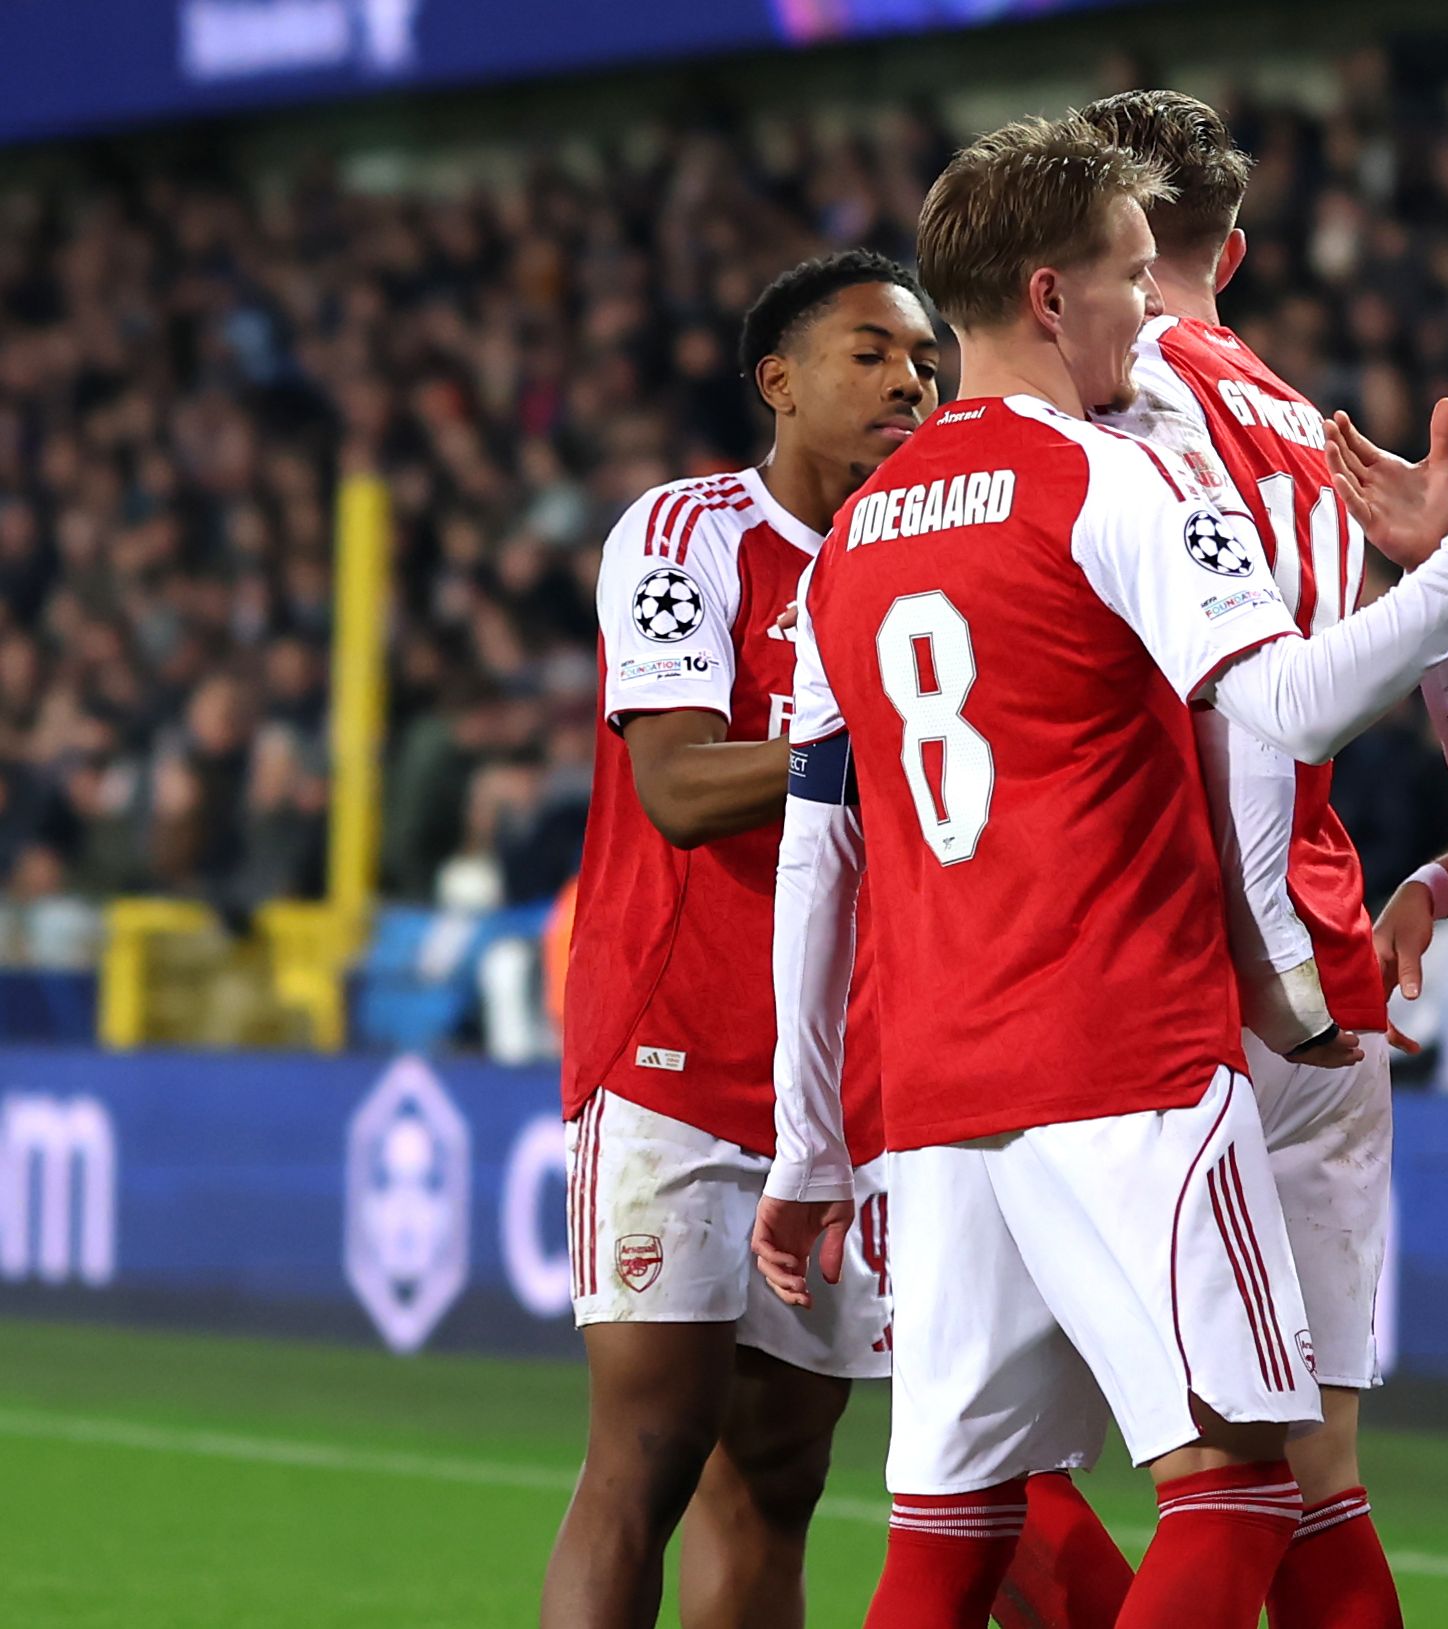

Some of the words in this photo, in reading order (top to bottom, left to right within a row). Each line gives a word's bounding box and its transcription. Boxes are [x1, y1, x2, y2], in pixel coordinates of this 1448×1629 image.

[936, 405, 987, 426] Arsenal
[846, 469, 1016, 552] ØDEGAARD
[876, 589, 995, 867] 8
